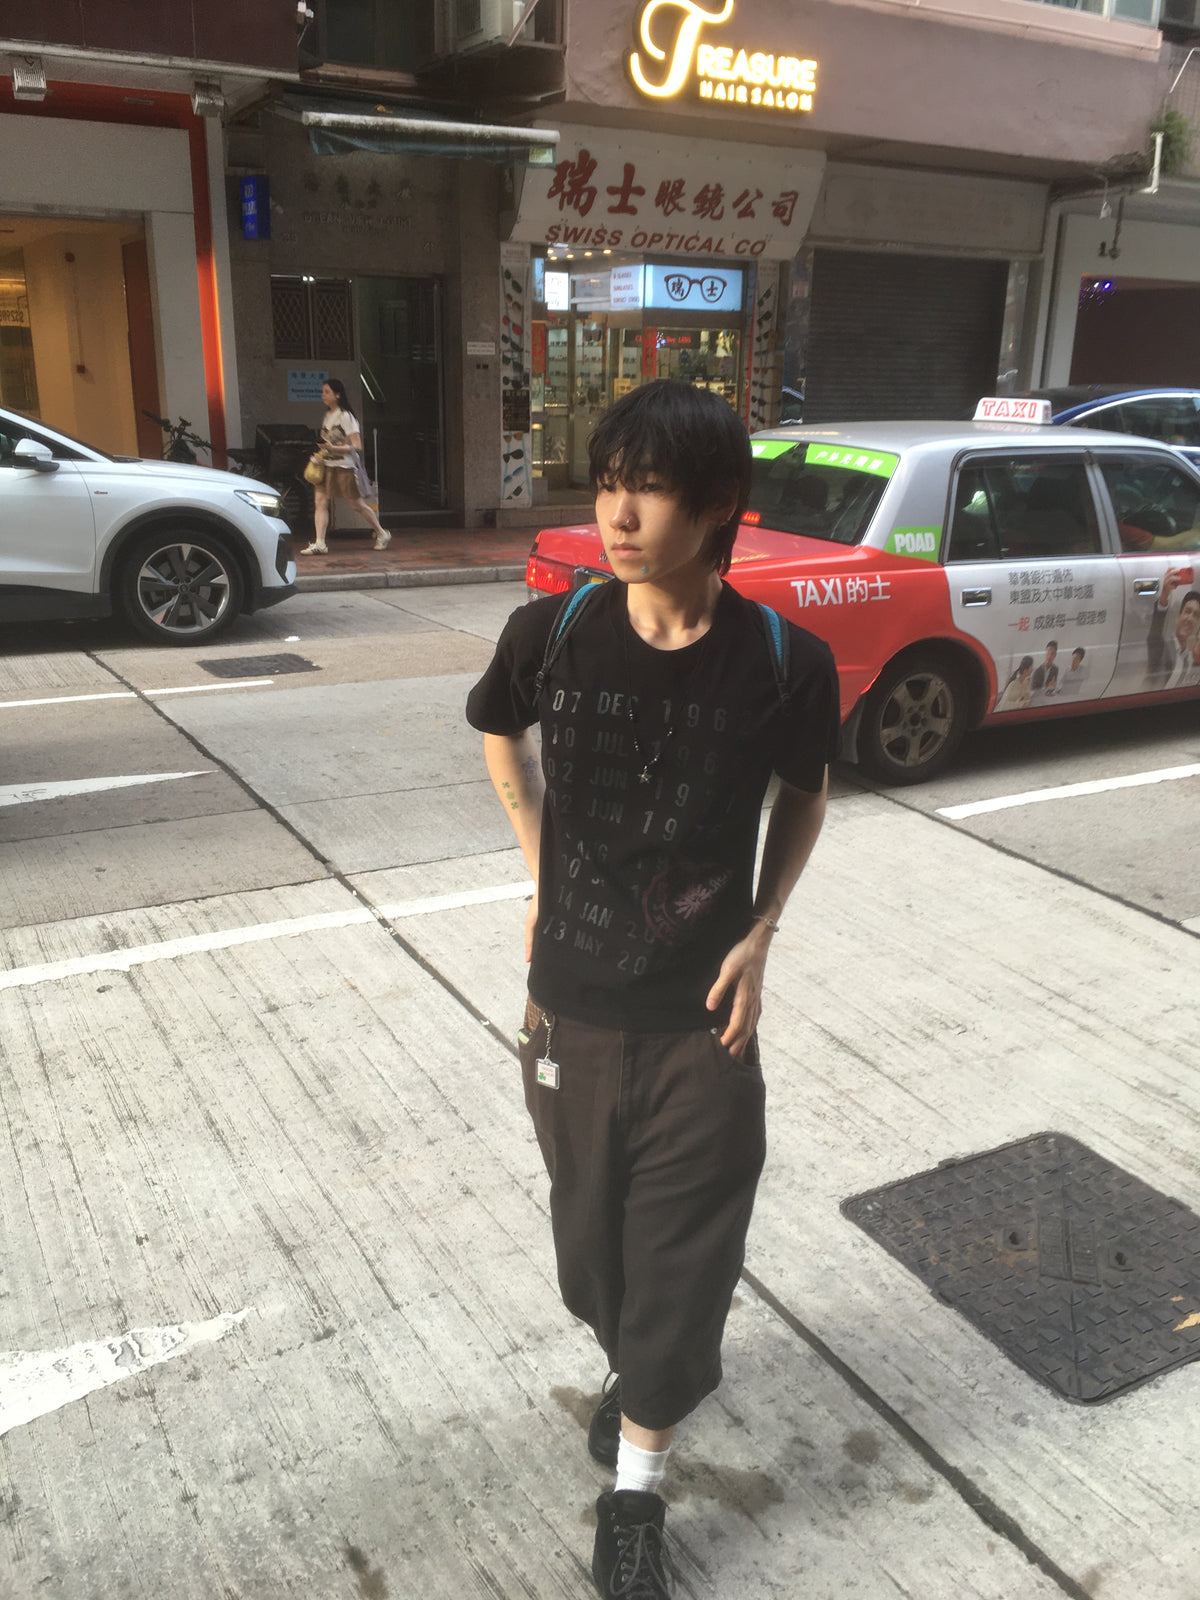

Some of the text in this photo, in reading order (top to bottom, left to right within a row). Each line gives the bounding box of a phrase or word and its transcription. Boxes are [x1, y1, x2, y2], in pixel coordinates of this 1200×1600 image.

[630, 0, 818, 97] TREASURE
[547, 148, 799, 227] 瑞士眼鏡公司
[545, 224, 768, 257] SWISS OPTICAL CO
[982, 400, 1038, 419] TAXI
[894, 532, 936, 554] POAD
[790, 574, 891, 608] TAXI 的士
[552, 689, 583, 714] 07
[592, 731, 630, 758] JUL
[589, 766, 628, 791] JUN
[587, 797, 624, 824] JUN
[578, 901, 615, 929] JAN
[573, 929, 605, 957] MAY
